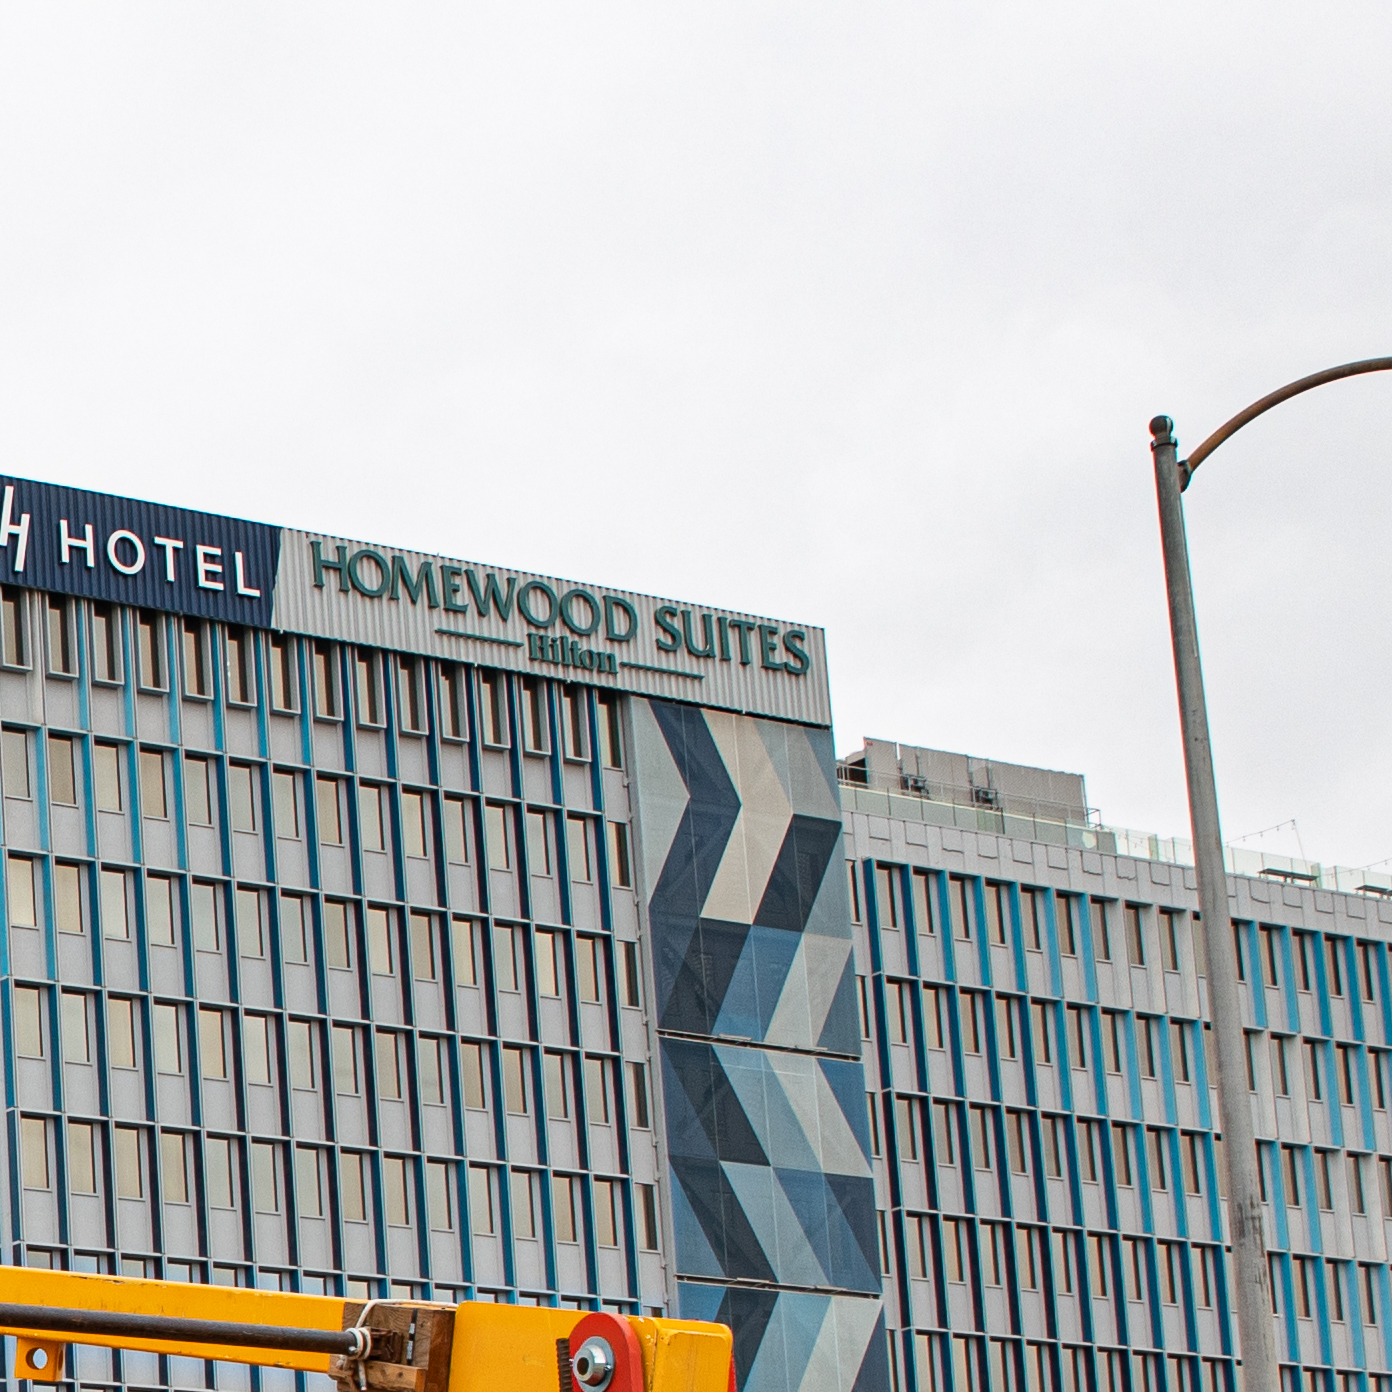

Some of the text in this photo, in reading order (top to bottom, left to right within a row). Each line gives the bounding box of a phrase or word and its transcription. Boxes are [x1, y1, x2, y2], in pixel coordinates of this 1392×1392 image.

[59, 519, 261, 598] HOTEL
[310, 541, 810, 675] HOMEWOOD SUITES
[527, 632, 618, 674] Hilton
